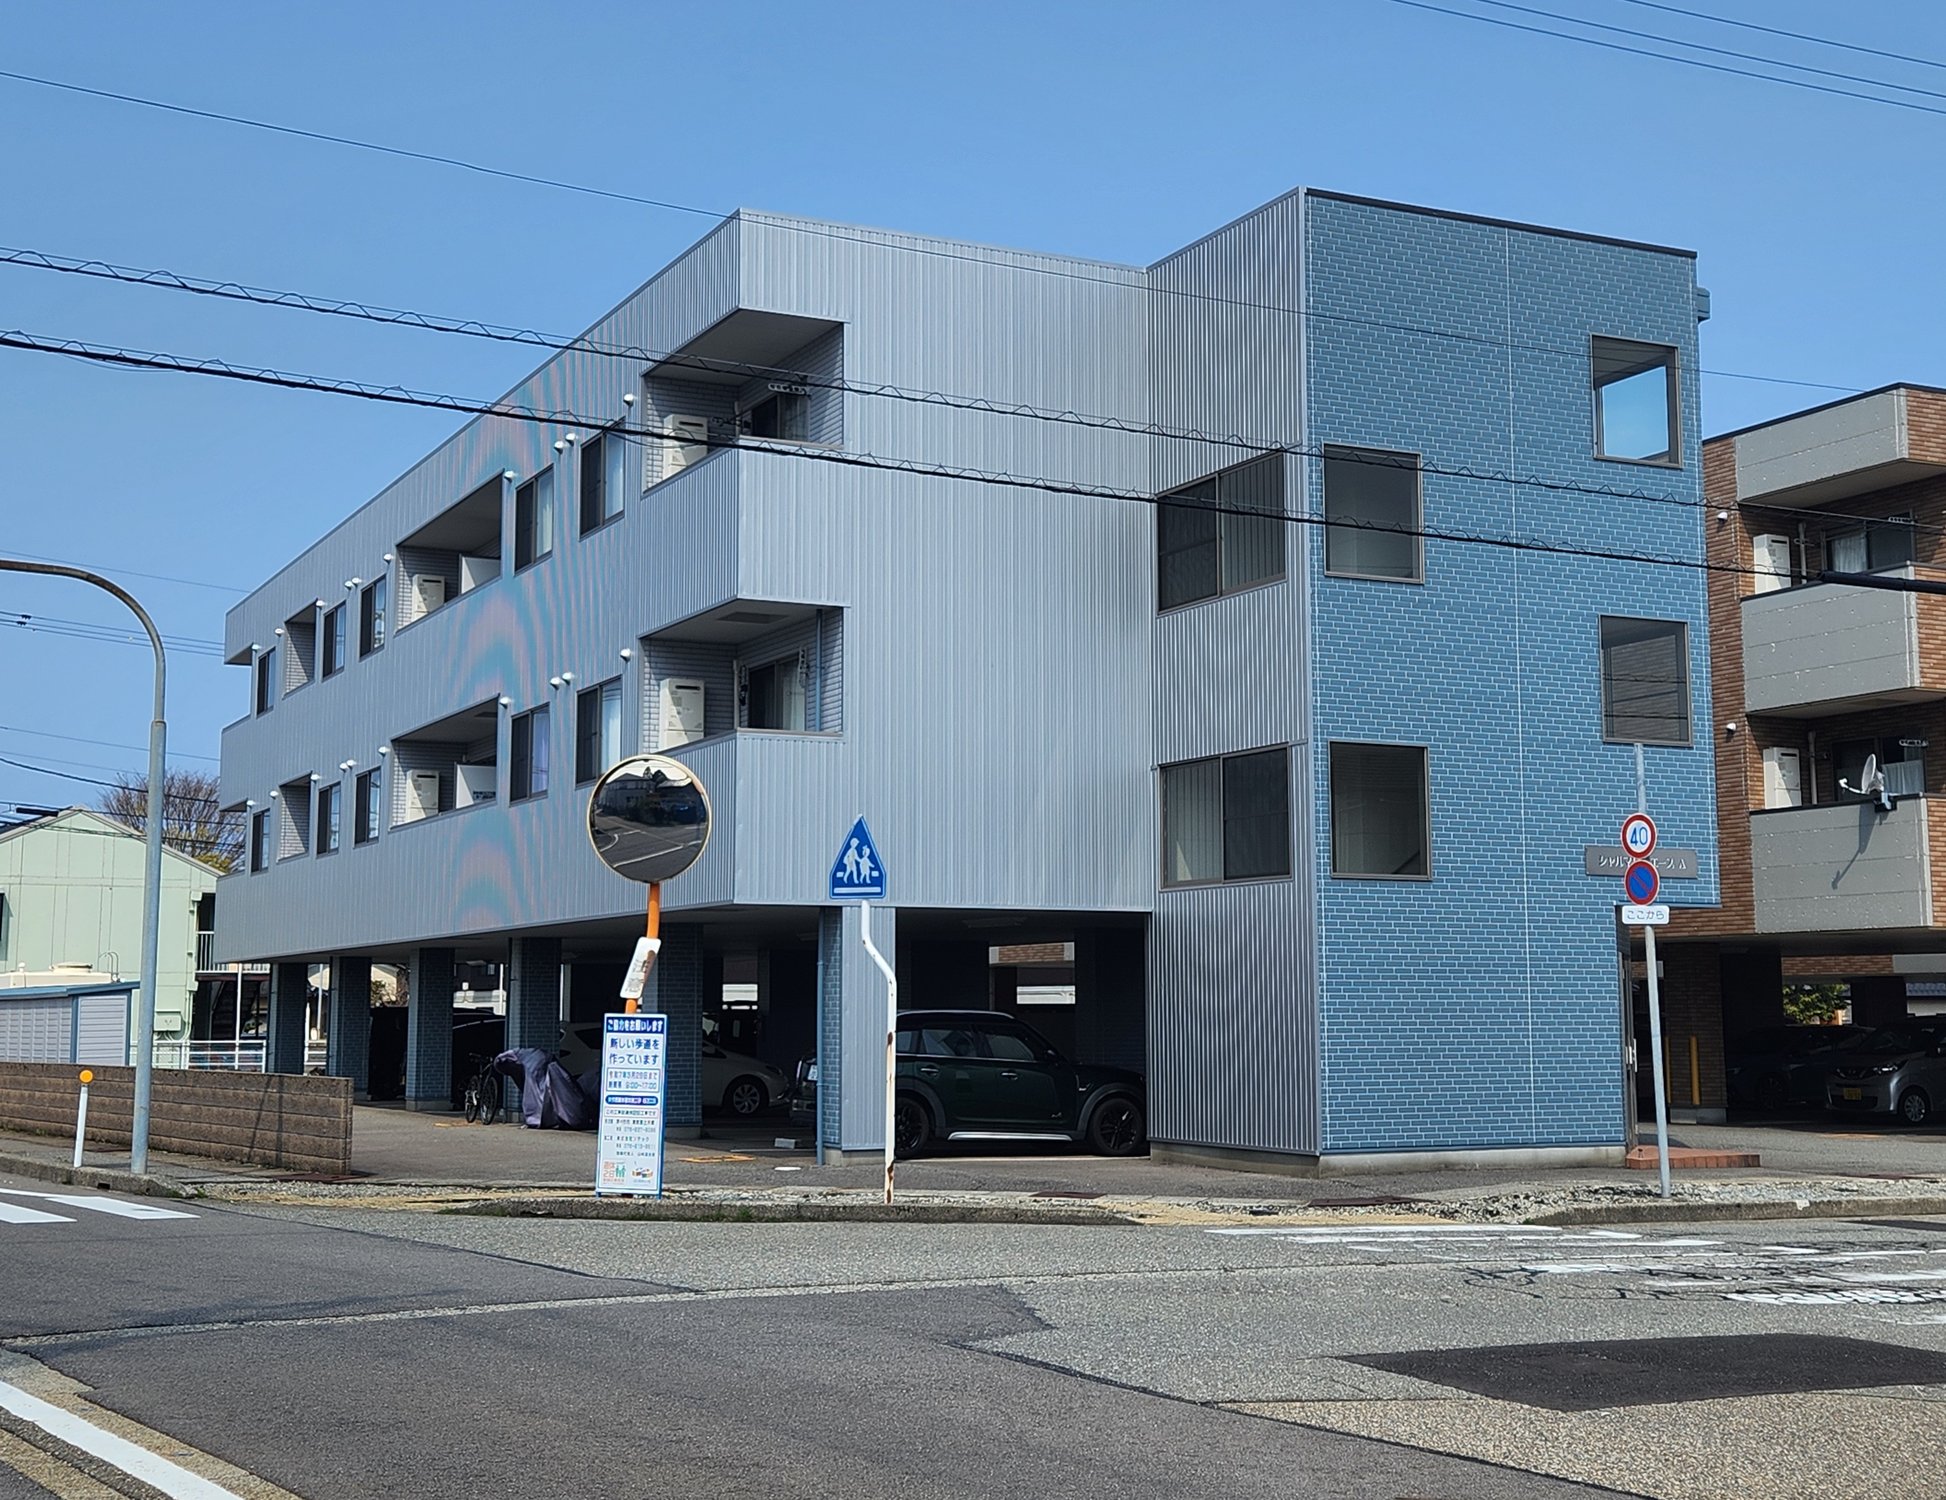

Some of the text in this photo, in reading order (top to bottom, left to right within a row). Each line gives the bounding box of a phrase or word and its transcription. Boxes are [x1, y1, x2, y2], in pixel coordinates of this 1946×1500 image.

[1631, 827, 1647, 845] 40
[1627, 911, 1664, 919] ここから
[610, 1038, 659, 1049] 新しい歩道を
[609, 1053, 658, 1064] 作っています
